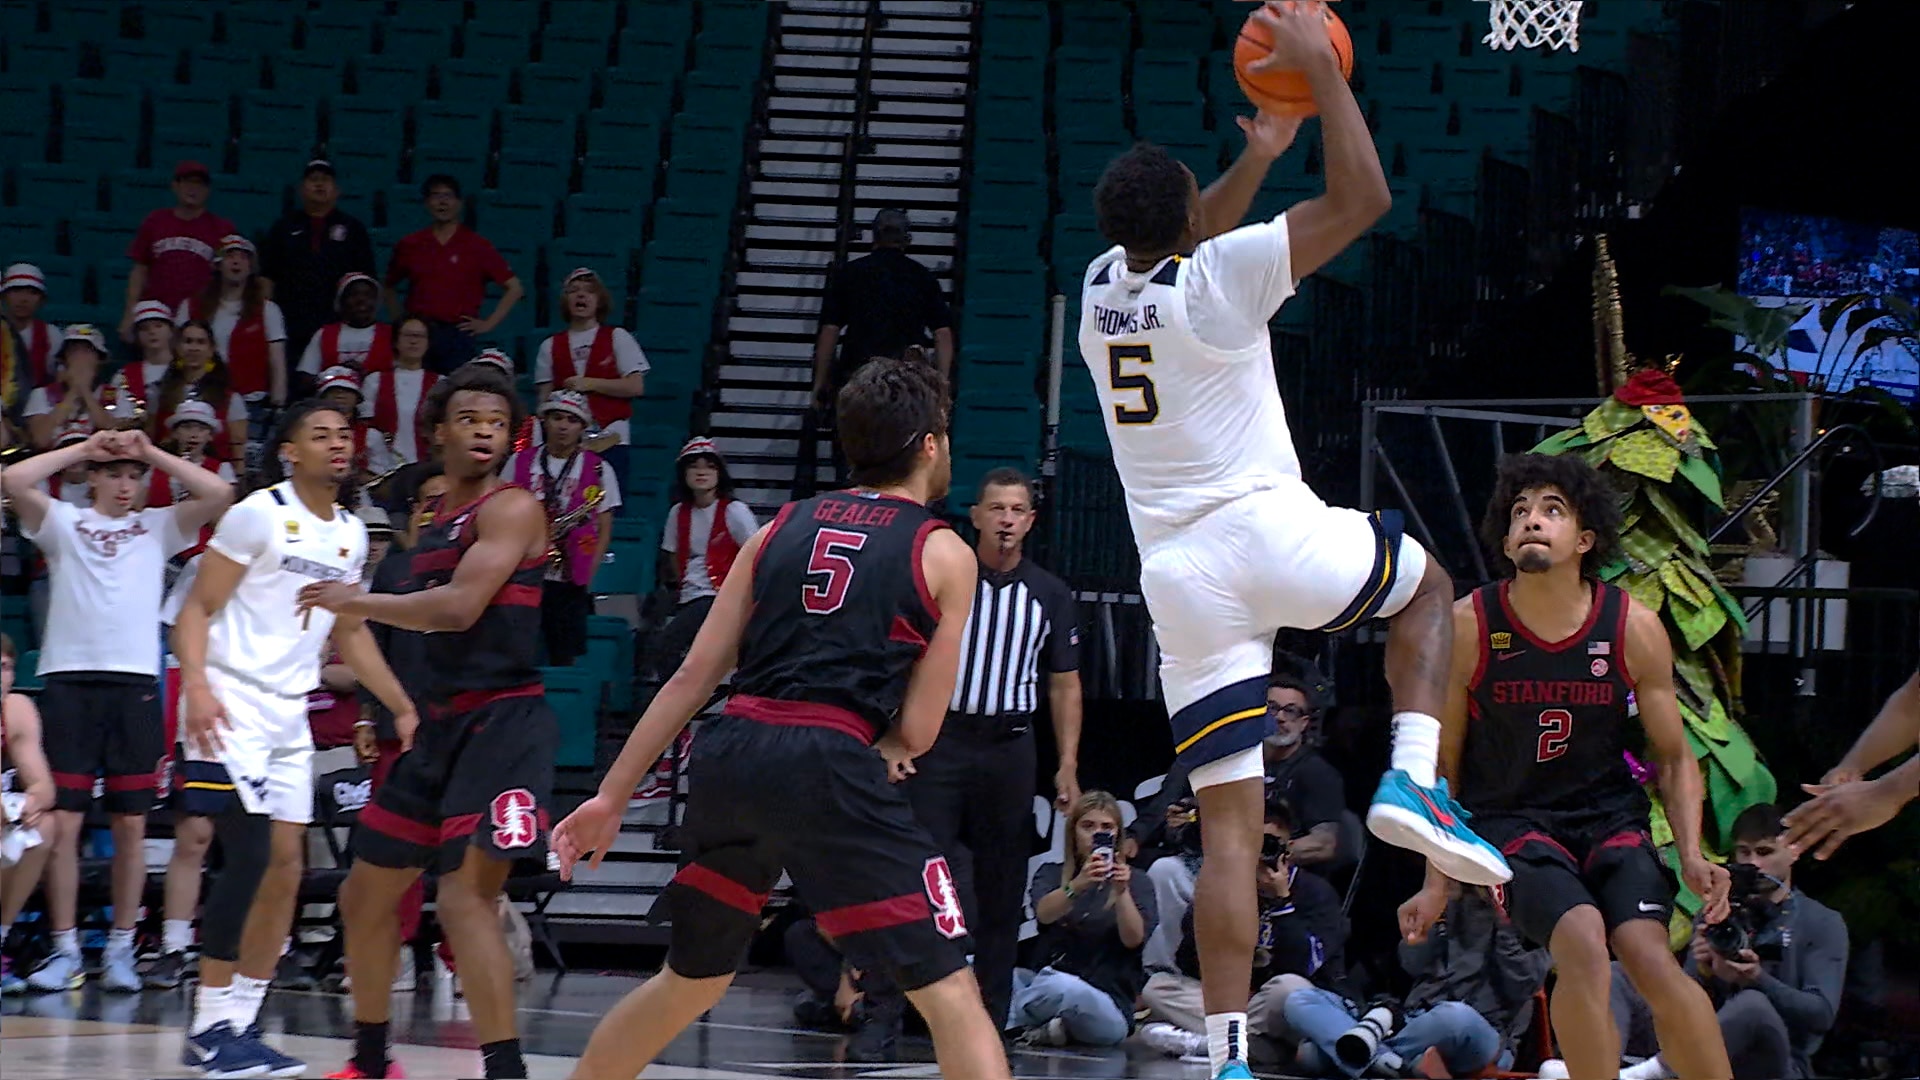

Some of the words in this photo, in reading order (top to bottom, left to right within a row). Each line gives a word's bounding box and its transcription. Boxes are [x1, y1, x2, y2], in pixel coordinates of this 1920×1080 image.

[1094, 304, 1138, 335] THOMS
[1141, 304, 1165, 330] JR.
[1107, 344, 1159, 425] 5
[813, 499, 899, 528] GEALER
[802, 527, 868, 614] 5
[1493, 681, 1614, 705] STANFORD
[1537, 708, 1573, 762] 2
